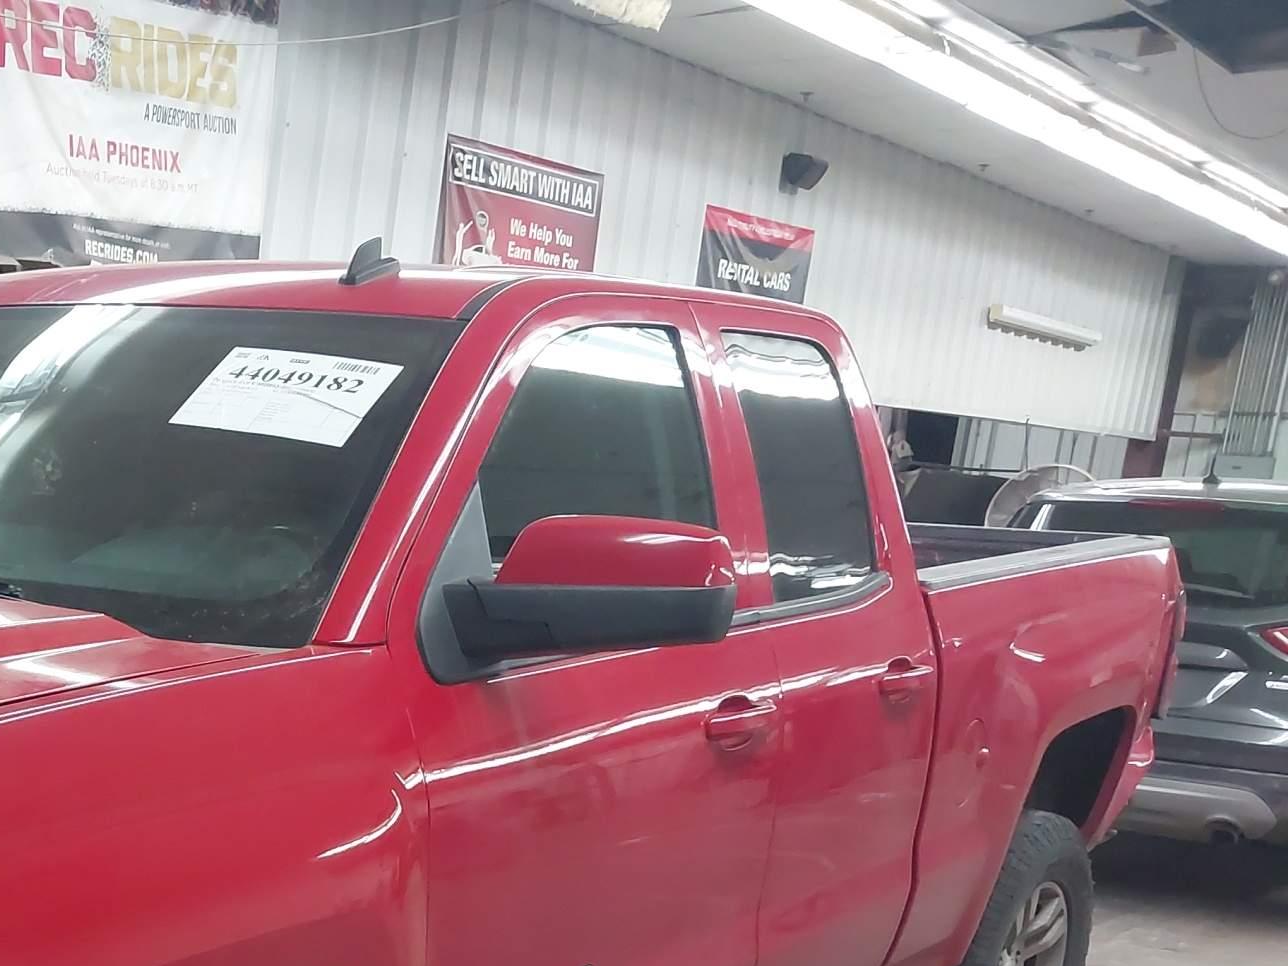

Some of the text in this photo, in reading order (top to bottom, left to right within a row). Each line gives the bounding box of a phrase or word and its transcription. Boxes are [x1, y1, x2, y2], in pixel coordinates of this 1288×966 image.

[111, 16, 239, 108] RIDES
[144, 103, 238, 135] A POWERSPORT AUCTION
[69, 134, 182, 173] IAA PHOENIX
[454, 152, 593, 209] SELL SMART WITH IAA
[510, 218, 573, 247] We Help You
[507, 241, 579, 270] Earn More For
[717, 258, 792, 292] RENTAL CARS
[228, 365, 364, 394] 44049182
